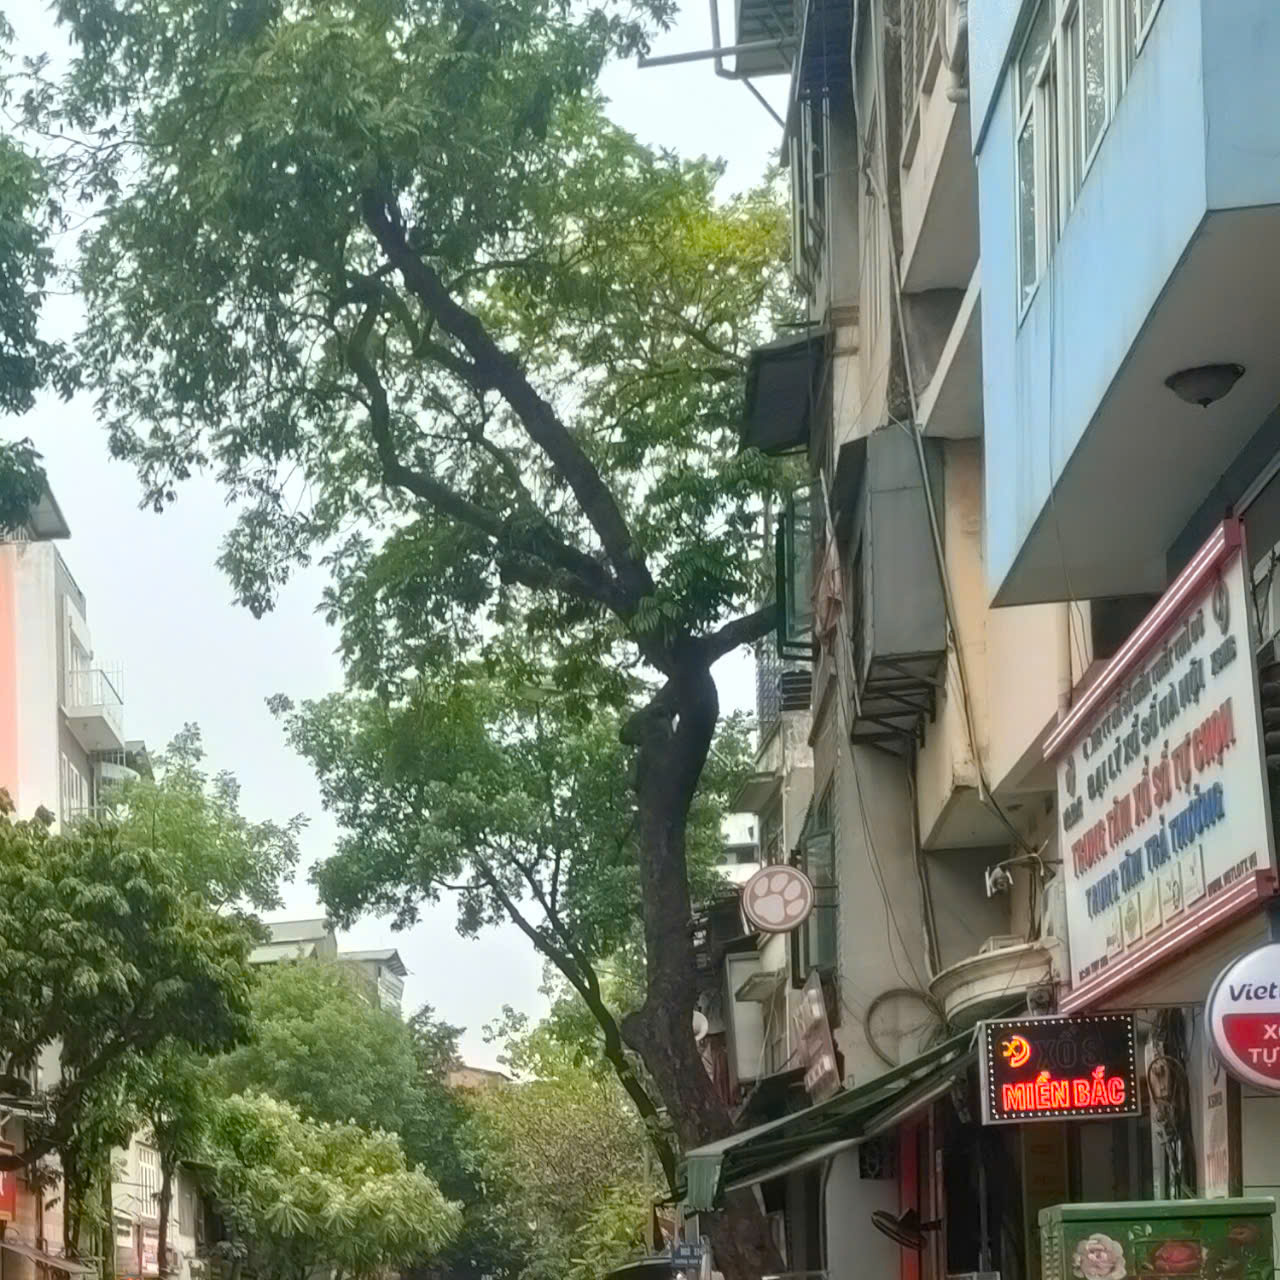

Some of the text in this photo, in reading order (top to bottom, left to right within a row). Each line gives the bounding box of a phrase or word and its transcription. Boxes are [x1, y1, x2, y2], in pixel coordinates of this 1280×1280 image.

[1071, 819, 1108, 880] TRUNG
[1106, 794, 1134, 849] TÂM
[1229, 982, 1280, 1001] Viet
[1263, 1024, 1280, 1039] X
[1248, 1046, 1280, 1067] TỰ
[1002, 1065, 1126, 1111] MIỀN BẮC
